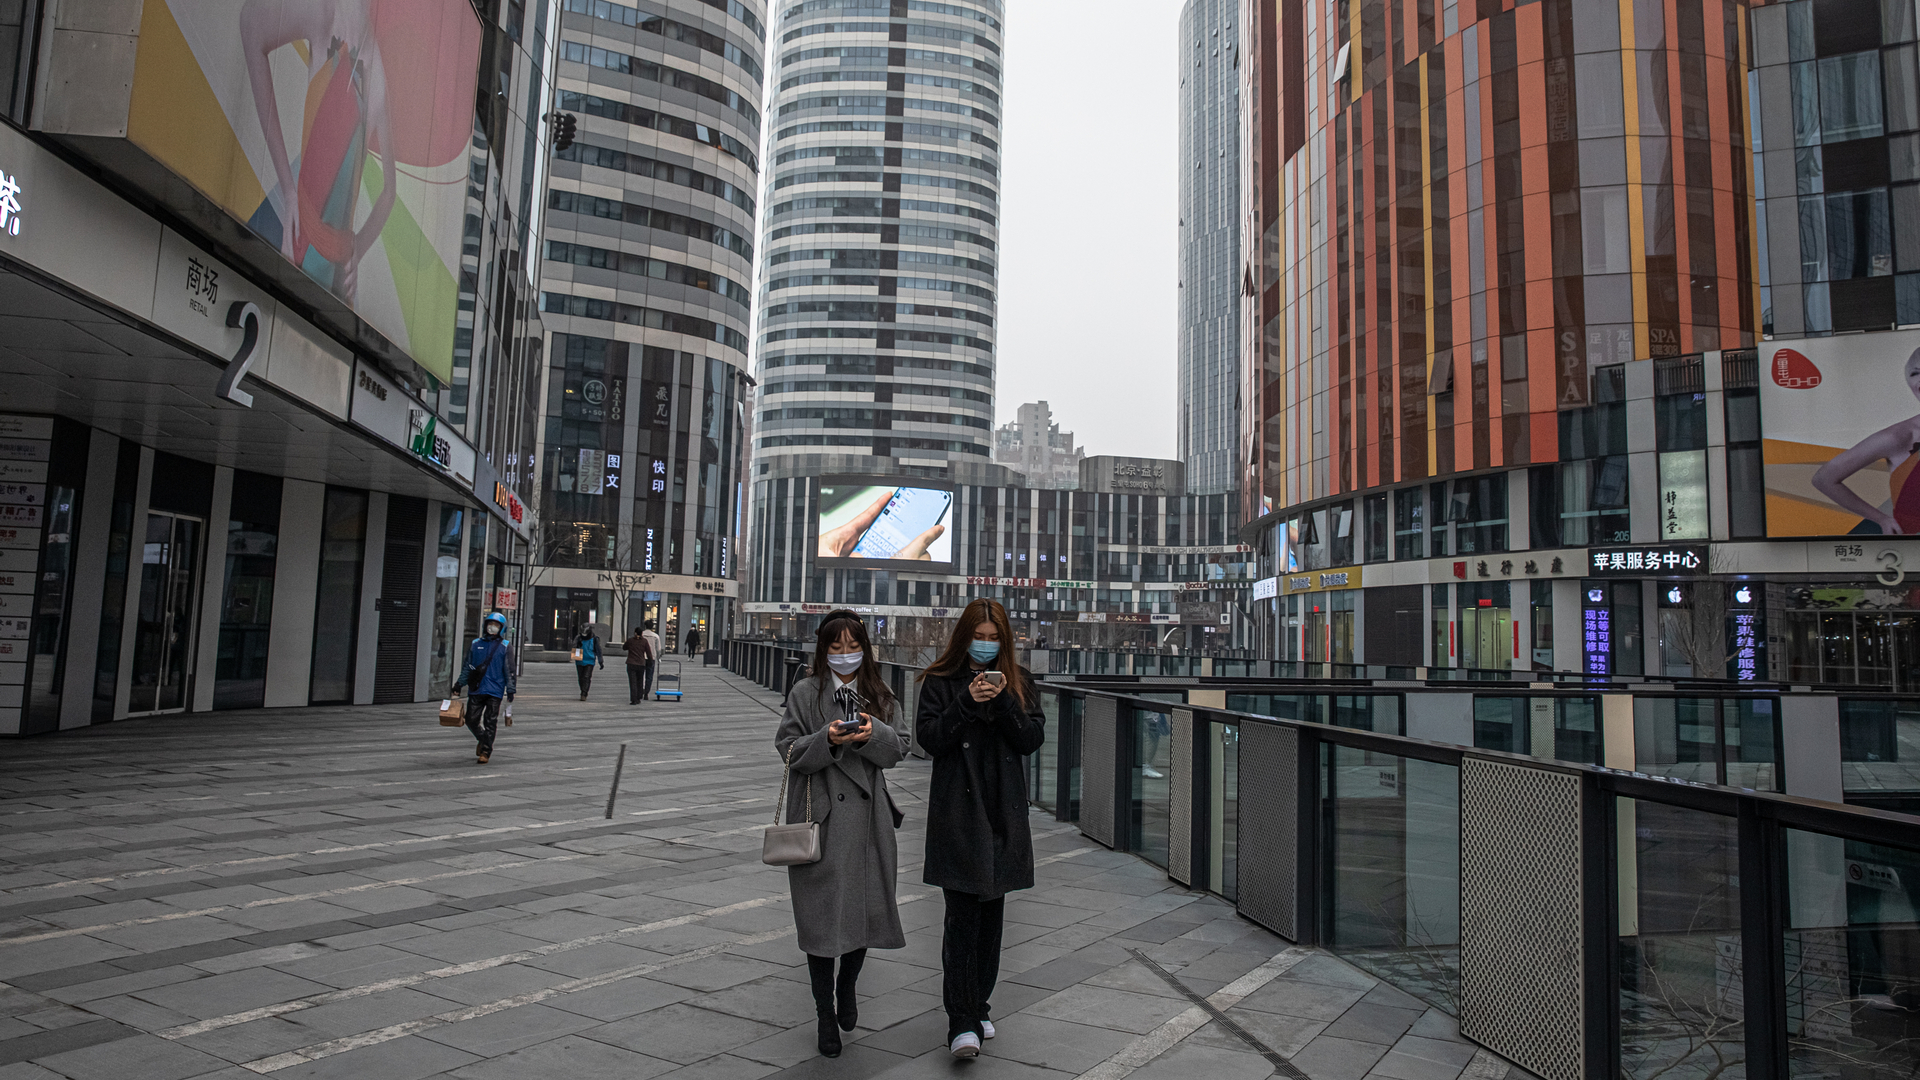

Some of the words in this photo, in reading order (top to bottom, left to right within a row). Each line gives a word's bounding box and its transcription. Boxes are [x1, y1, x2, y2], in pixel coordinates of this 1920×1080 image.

[186, 257, 218, 305] 商场
[189, 298, 208, 317] RETAIL
[1650, 328, 1676, 343] SPA
[216, 301, 262, 409] 2
[1561, 331, 1581, 401] SPA
[1779, 376, 1819, 388] SOHO
[611, 379, 622, 420] TATTOO
[606, 454, 620, 488] 图文
[652, 460, 666, 493] 快印
[647, 528, 654, 540] IN
[1614, 531, 1630, 541] 205
[645, 541, 653, 571] STYLE
[1594, 551, 1700, 571] 苹果服务中心
[1834, 545, 1863, 557] 商场
[1876, 548, 1905, 586] 3
[615, 575, 652, 584] STYLE
[1585, 609, 1597, 652] 现场维修
[1598, 609, 1609, 653] 立等可取
[1736, 614, 1755, 680] 苹果维修服务
